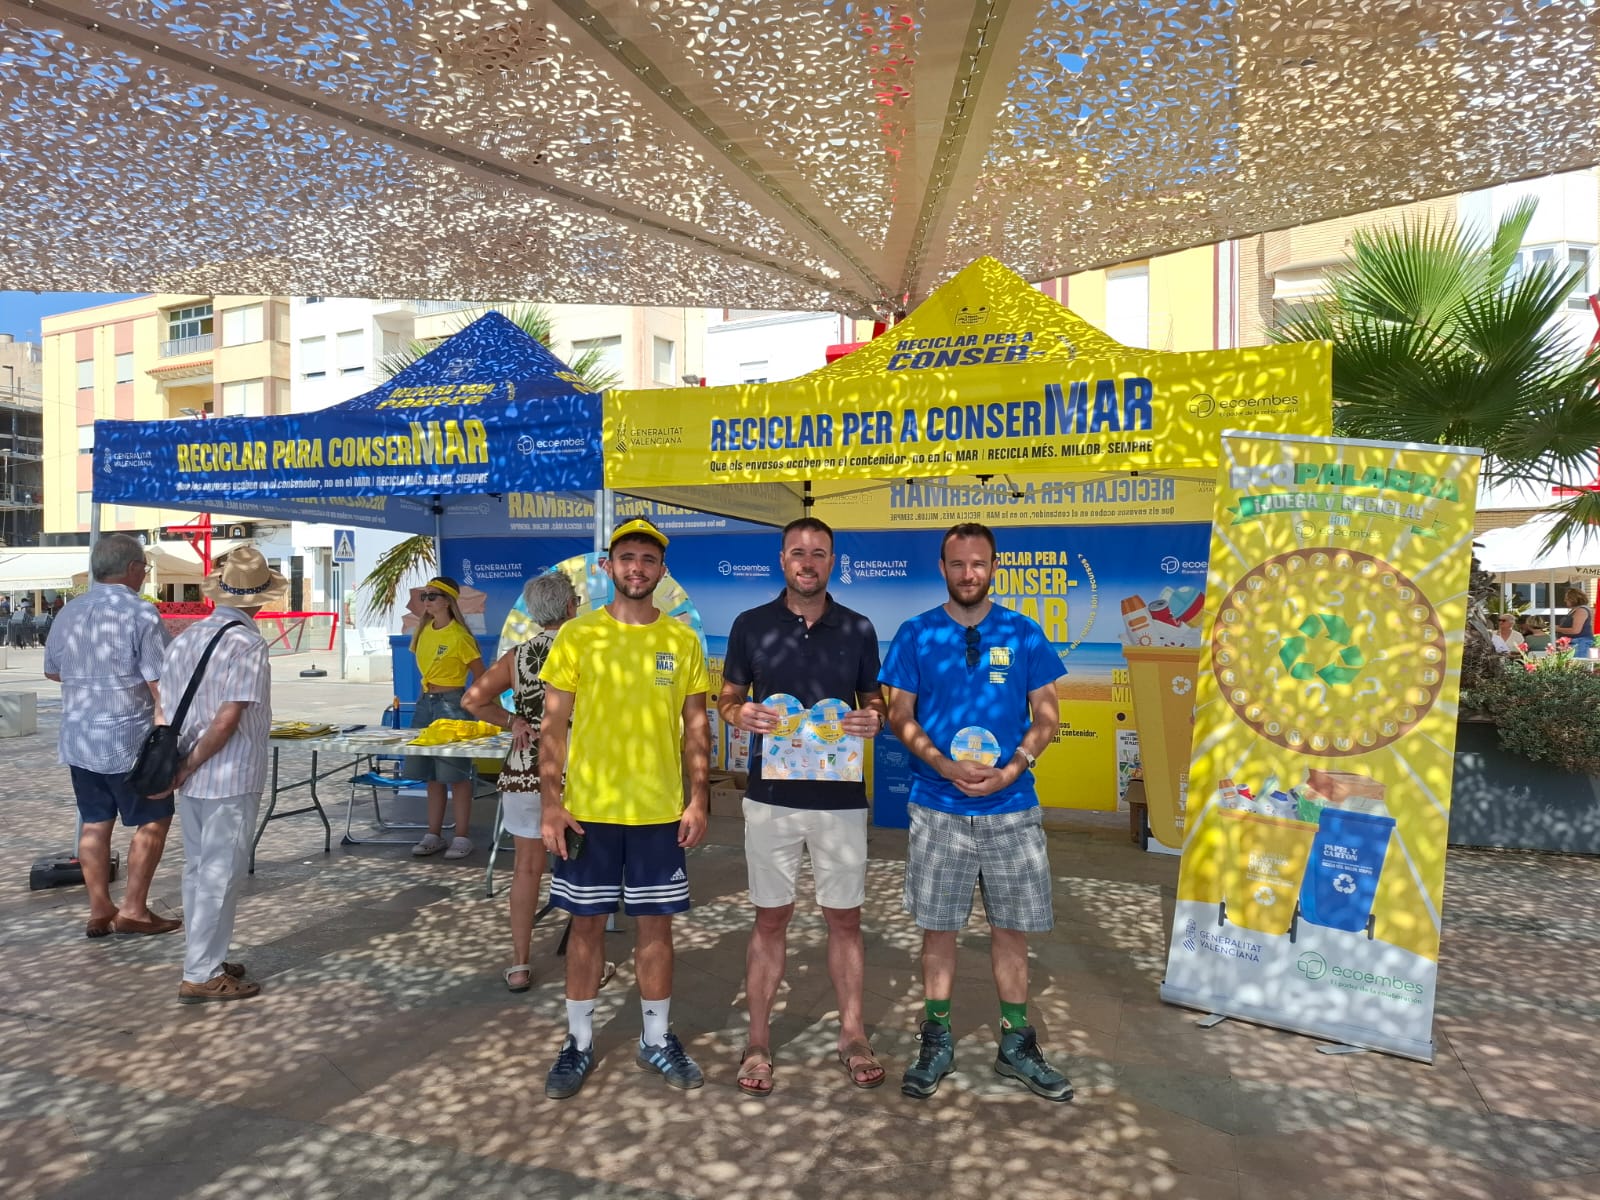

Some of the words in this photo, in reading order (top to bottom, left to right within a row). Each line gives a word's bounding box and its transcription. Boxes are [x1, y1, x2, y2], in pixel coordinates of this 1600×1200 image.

[897, 334, 977, 351] RECICLAR
[983, 333, 1017, 345] PER
[1020, 332, 1035, 343] A
[1219, 394, 1298, 408] ecoembes
[711, 413, 834, 451] RECICLAR
[842, 410, 892, 446] PER
[900, 409, 919, 442] A
[926, 377, 1153, 442] CONSERMAR
[631, 427, 683, 437] GENERALITAT
[176, 441, 267, 472] RECICLAR
[273, 438, 324, 469] PARA
[327, 418, 489, 468] CONSERMAR
[536, 437, 585, 448] ecoembes
[631, 436, 683, 446] VALENCIANA
[710, 461, 727, 473] Que
[729, 459, 743, 471] els
[745, 460, 783, 470] envasos
[787, 457, 821, 469] acaben
[824, 458, 836, 467] en
[838, 455, 848, 467] el
[912, 454, 924, 464] no
[927, 454, 940, 463] en
[943, 450, 953, 461] la
[956, 450, 978, 461] MAR
[988, 447, 1028, 460] RECICLA
[1107, 440, 1153, 454] SEMPRE
[324, 479, 333, 488] no
[1341, 496, 1425, 520] RECICLA!
[1035, 551, 1057, 566] PER
[1059, 551, 1068, 566] A
[1315, 555, 1324, 565] Z
[1338, 558, 1348, 568] A
[474, 563, 523, 571] GENERALITAT
[733, 564, 771, 572] ecoembes
[854, 560, 908, 569] GENERALITAT
[1291, 560, 1300, 569] Y
[1361, 564, 1370, 574] B
[475, 571, 523, 579] VALENCIANA
[854, 569, 908, 577] VALENCIANA
[1270, 567, 1278, 576] X
[1248, 580, 1262, 590] W
[1383, 575, 1391, 586] C
[1237, 594, 1246, 604] V
[1401, 589, 1410, 599] D
[1226, 611, 1235, 620] U
[1414, 608, 1422, 618] E
[1424, 629, 1431, 639] F
[1222, 652, 1229, 662] S
[1425, 649, 1437, 659] G
[656, 660, 674, 671] MAR
[1226, 671, 1235, 682] R
[1424, 671, 1435, 681] H
[1234, 690, 1245, 702] Q
[1252, 707, 1260, 718] P
[1268, 722, 1279, 733] O
[1384, 722, 1393, 732] K
[1062, 729, 1099, 739] contenidor,
[1363, 732, 1370, 743] L
[1313, 736, 1324, 746] N
[1337, 737, 1349, 747] M
[1200, 930, 1262, 952] GENERALITAT
[1200, 940, 1260, 962] VALENCIANA
[1332, 966, 1424, 994] ecoembes
